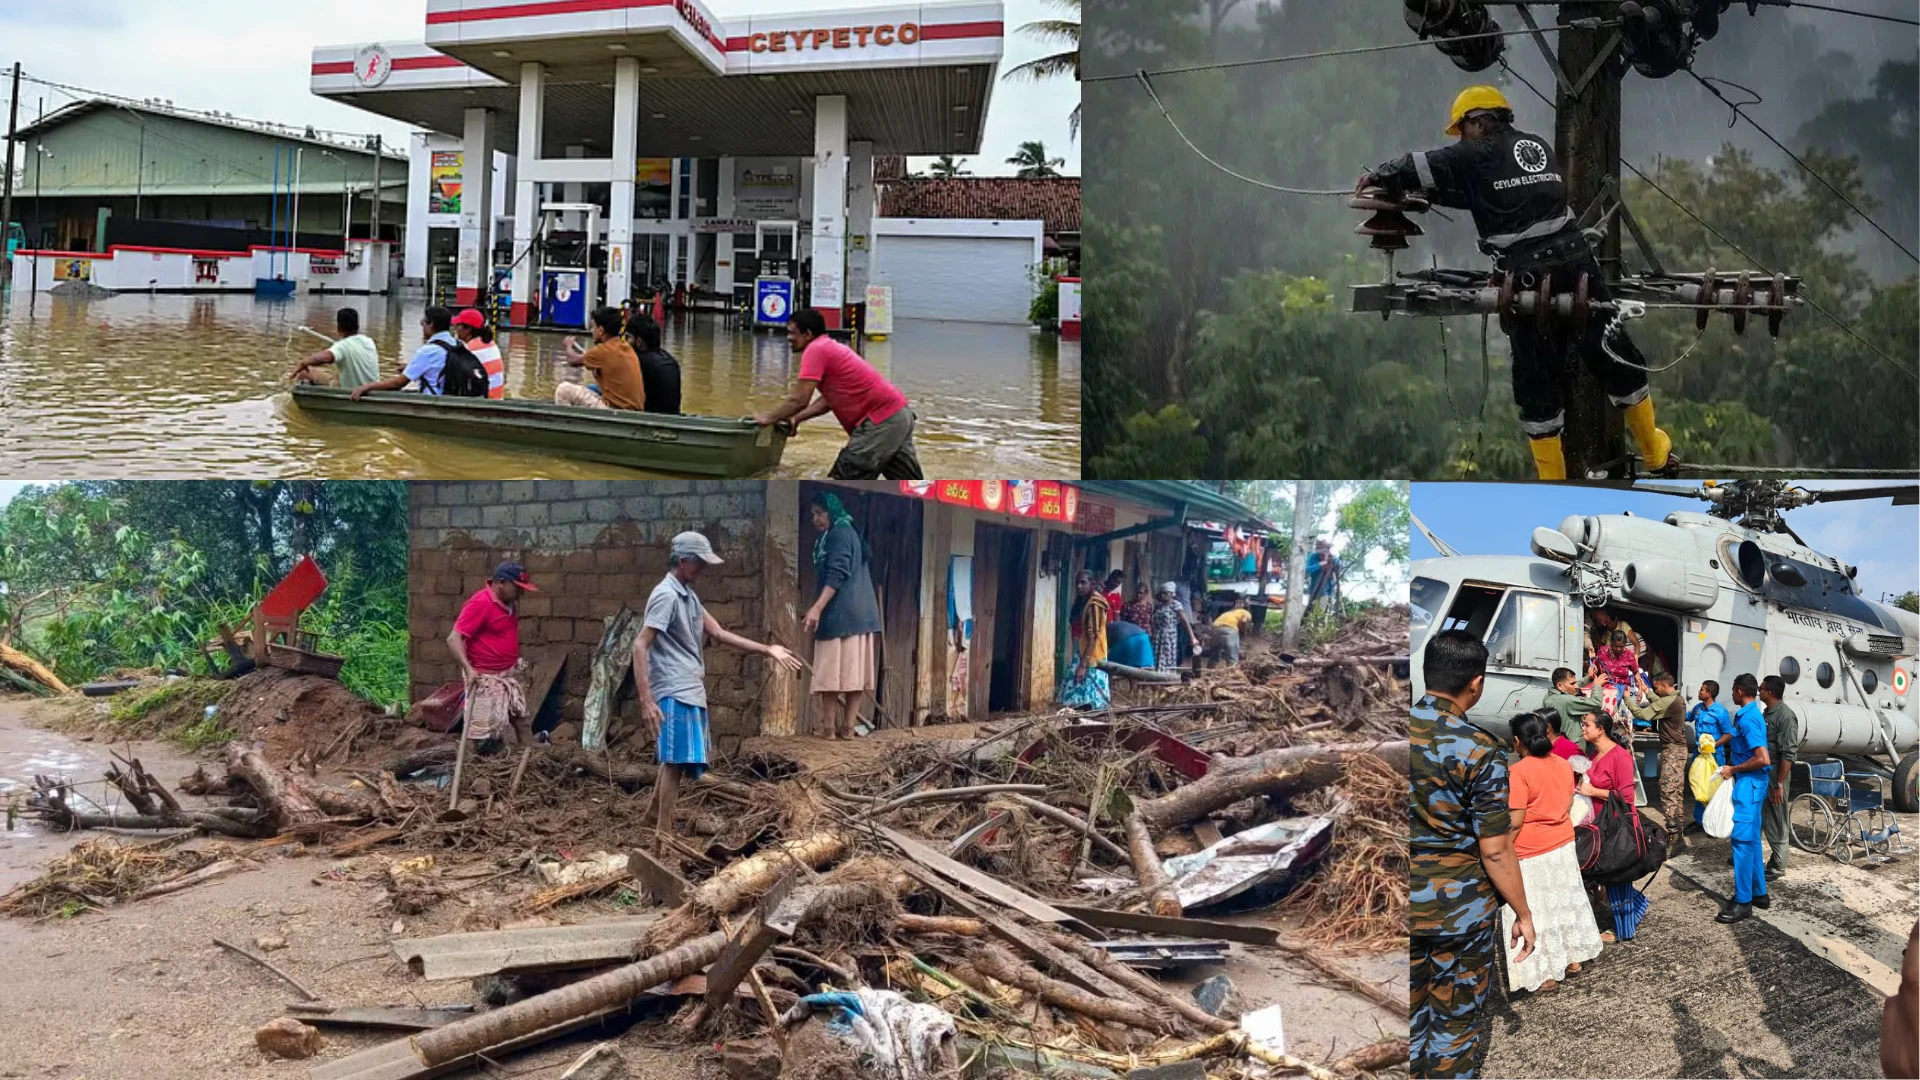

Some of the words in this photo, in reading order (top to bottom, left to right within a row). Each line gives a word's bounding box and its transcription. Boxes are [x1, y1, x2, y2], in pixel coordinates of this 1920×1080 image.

[749, 23, 919, 53] CEYPETCO
[1493, 177, 1521, 190] CEYLON
[737, 219, 755, 227] FILL
[1785, 610, 1822, 629] भारतीय
[1825, 619, 1846, 638] वायु
